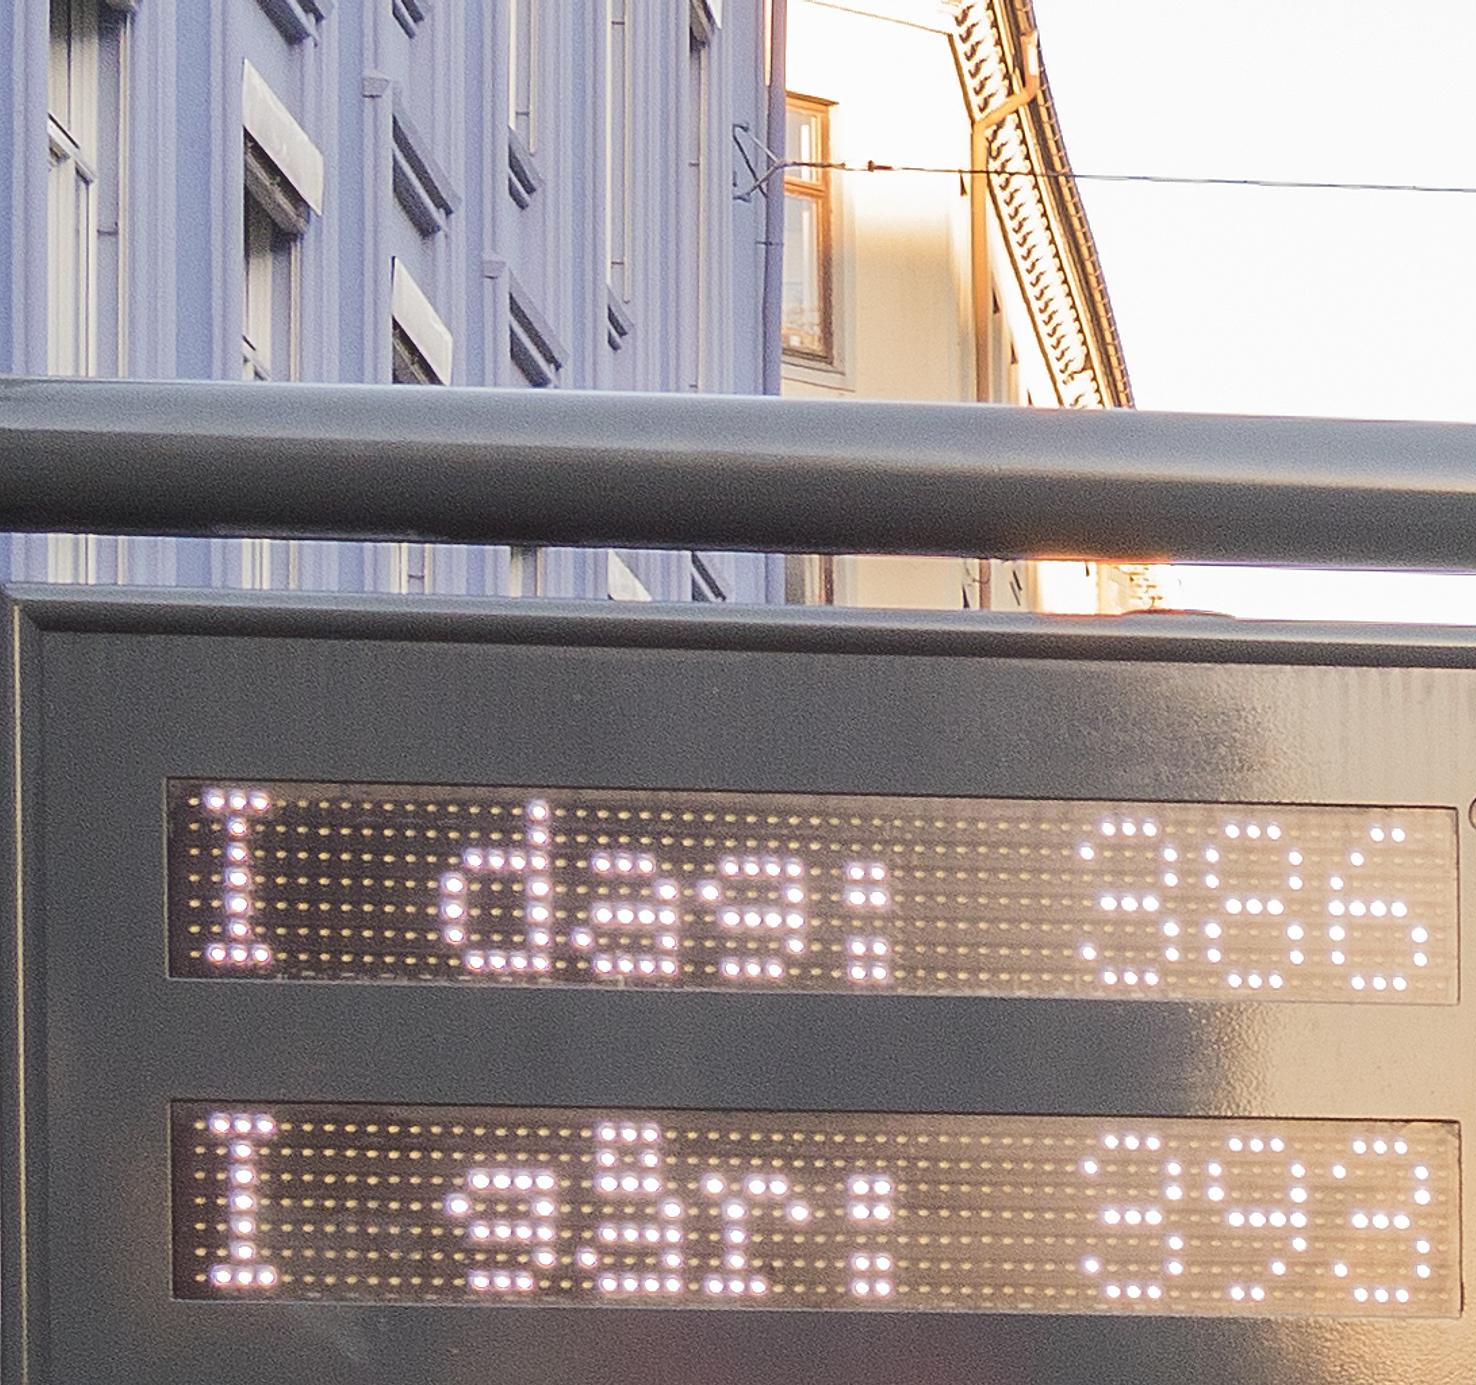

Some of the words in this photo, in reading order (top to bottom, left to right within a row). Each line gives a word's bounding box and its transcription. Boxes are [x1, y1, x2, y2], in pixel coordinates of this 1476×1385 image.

[205, 792, 271, 965] I
[440, 800, 889, 983] dag:
[1077, 820, 1430, 993] 386
[210, 1111, 278, 1288] I
[444, 1123, 894, 1299] går:
[1081, 1134, 1432, 1302] 393
